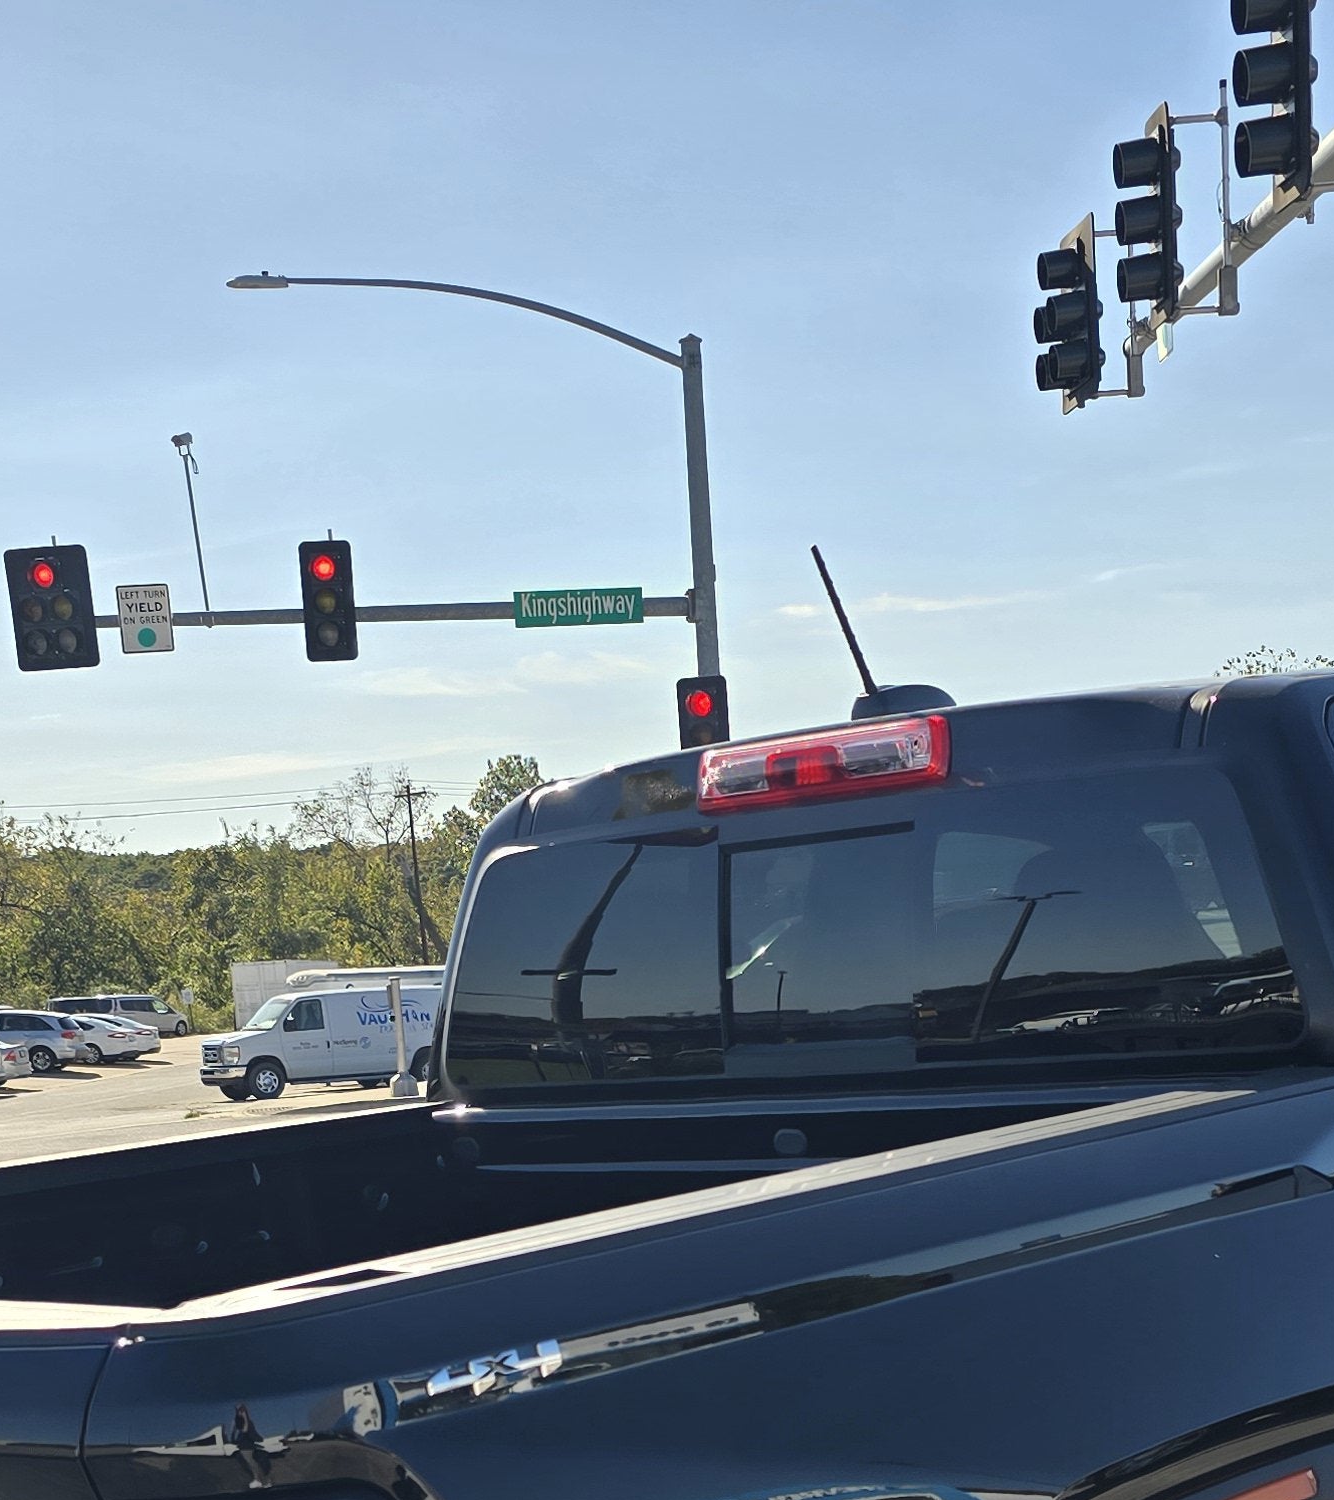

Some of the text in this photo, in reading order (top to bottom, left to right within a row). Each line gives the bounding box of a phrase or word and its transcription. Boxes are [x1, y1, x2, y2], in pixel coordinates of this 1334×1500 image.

[120, 590, 166, 600] LEFT TURN
[126, 602, 163, 613] YIELD
[521, 591, 635, 624] Kingshighway
[123, 615, 168, 625] ON GREEN
[356, 1010, 431, 1026] VAUHAN
